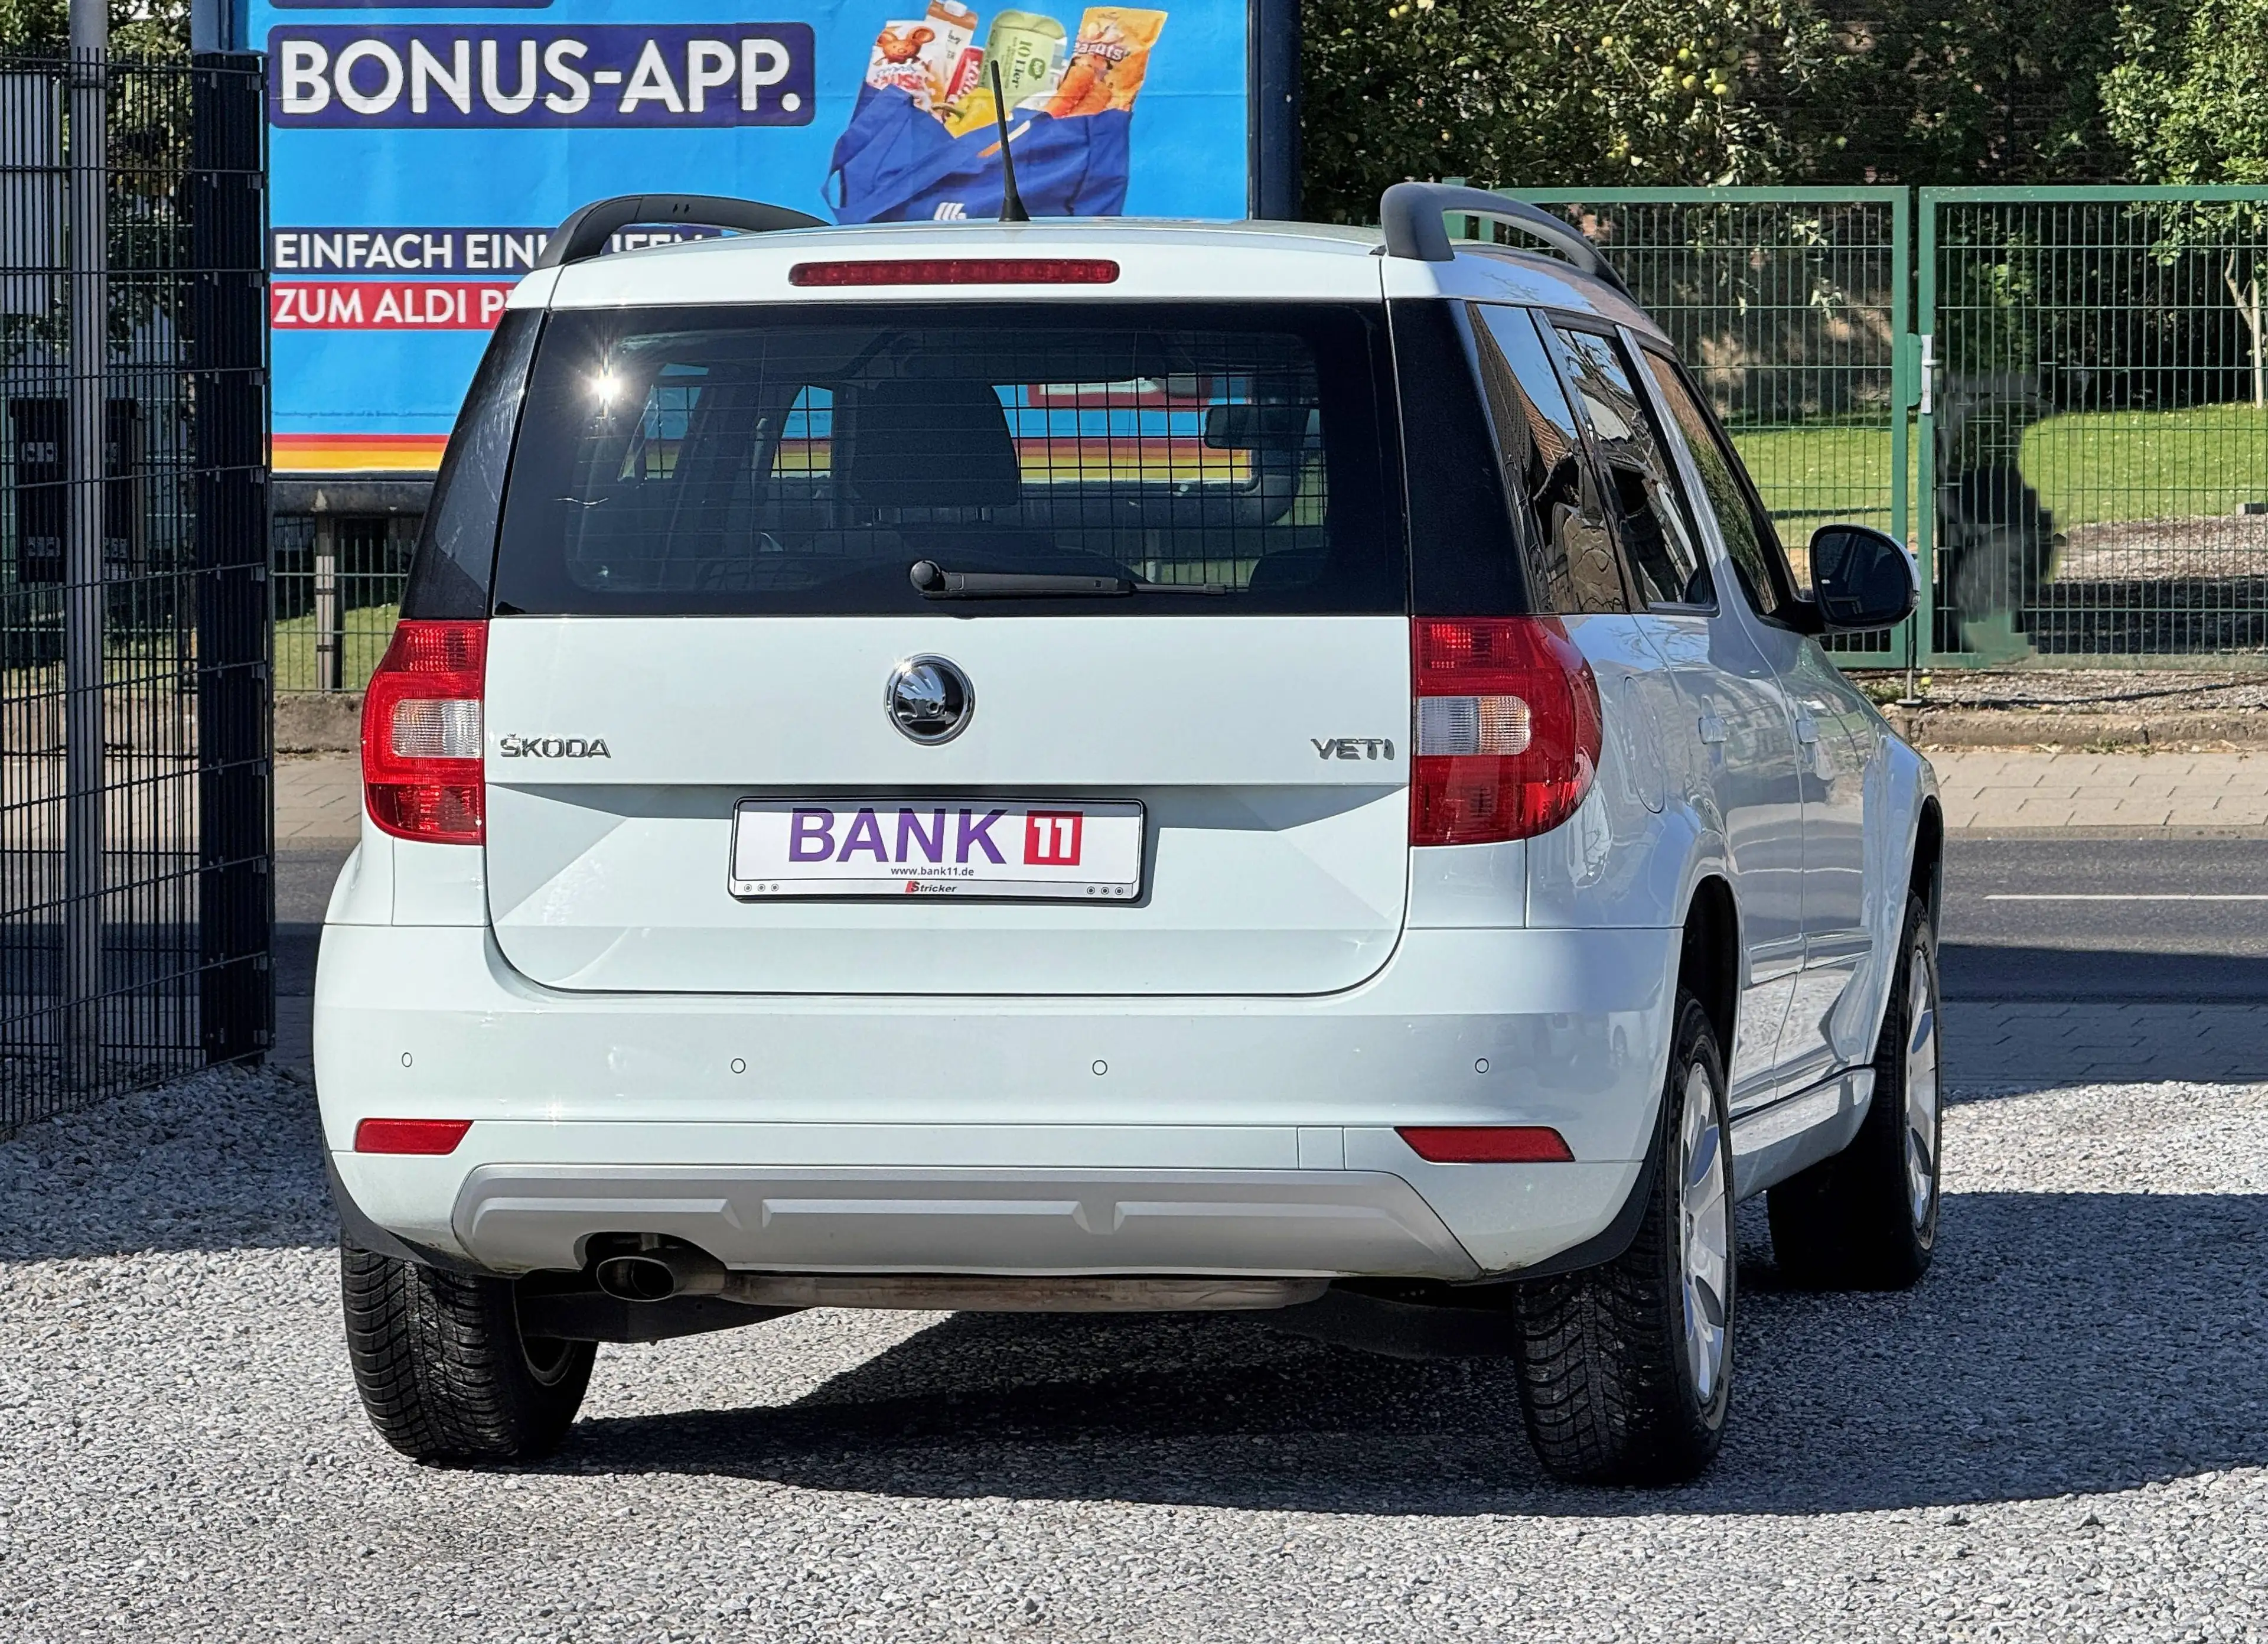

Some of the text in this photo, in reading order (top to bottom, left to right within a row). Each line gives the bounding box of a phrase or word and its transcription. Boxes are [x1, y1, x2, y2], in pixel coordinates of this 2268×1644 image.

[281, 39, 801, 115] BONUS-APP.
[275, 233, 458, 269] EINFACH
[274, 288, 364, 324] ZUM
[373, 288, 467, 324] ALDI
[1311, 738, 1395, 760] YETI
[788, 808, 1074, 864] BANK 11
[891, 867, 975, 876] www.bank11.de
[910, 881, 957, 893] Stricker
